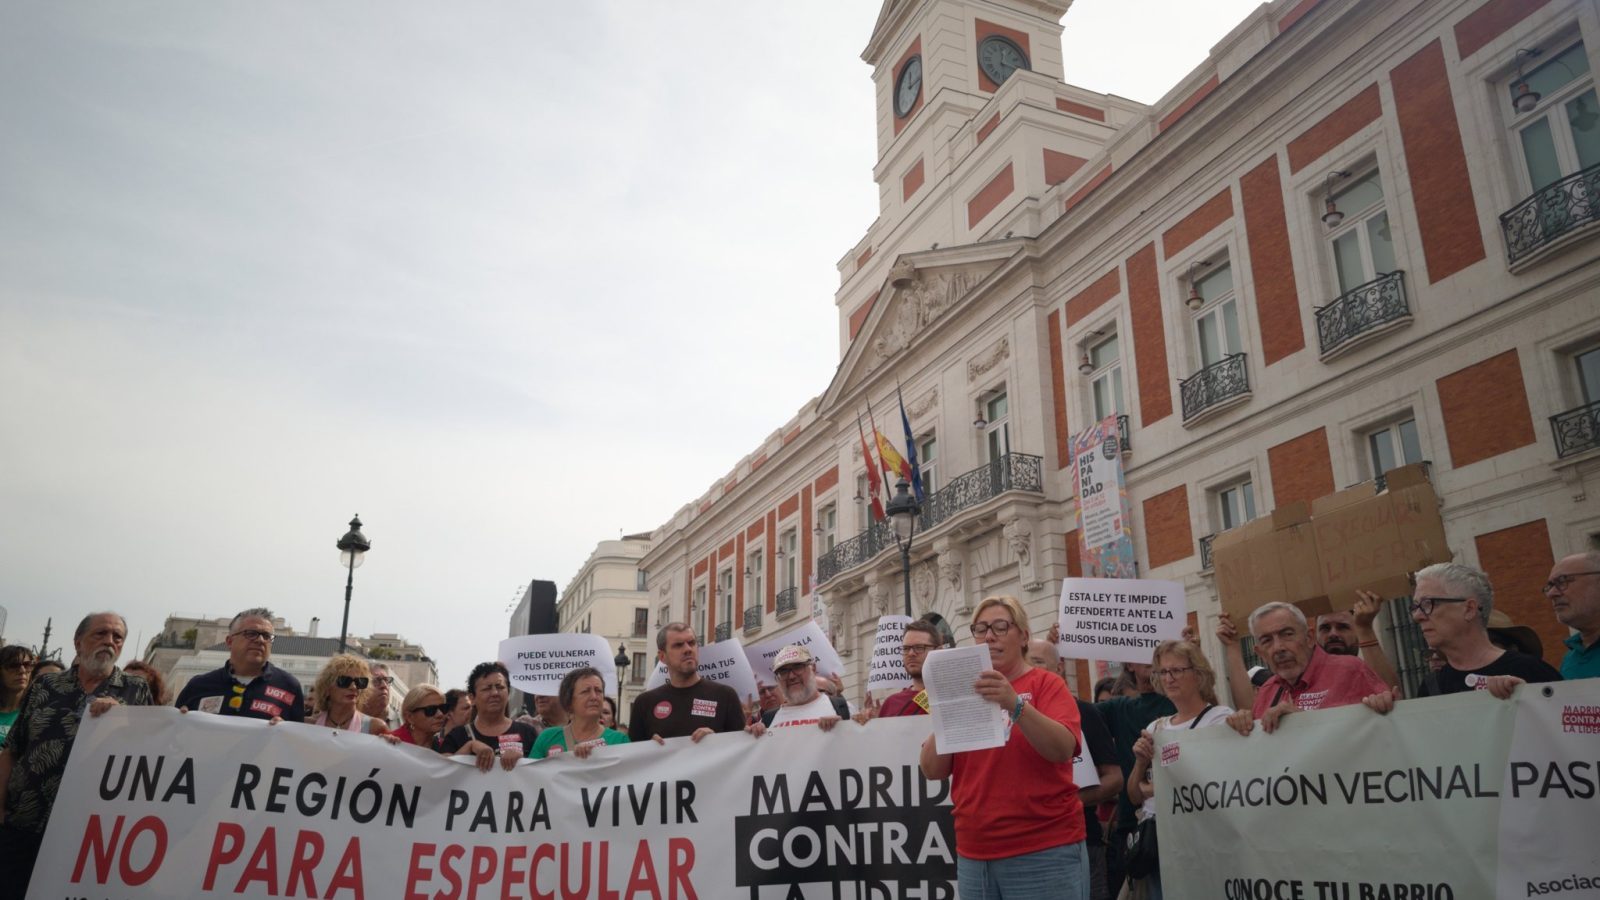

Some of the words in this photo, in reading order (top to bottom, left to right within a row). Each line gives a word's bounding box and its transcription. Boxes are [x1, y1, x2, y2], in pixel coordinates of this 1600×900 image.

[1080, 452, 1095, 467] HIS
[1080, 465, 1093, 478] PA
[1081, 476, 1091, 489] NI
[1082, 482, 1104, 498] DAD
[1069, 592, 1091, 601] ESTA
[1093, 593, 1111, 602] LEY
[1114, 594, 1126, 603] TE
[1128, 594, 1168, 605] IMPIDE
[1064, 606, 1126, 617] DEFENDERTE
[1127, 609, 1156, 619] ANTE
[1158, 610, 1173, 620] LA
[1076, 621, 1118, 631] JUSTICIA
[1120, 623, 1135, 633] DE
[1137, 624, 1157, 634] LOS
[1061, 633, 1096, 644] ABUSOS
[517, 651, 547, 660] PUEDE
[548, 649, 596, 658] VULNERAR
[524, 662, 541, 671] TUS
[542, 661, 590, 670] DERECHOS
[718, 658, 736, 668] TUS
[718, 671, 730, 680] DE
[265, 685, 285, 699] UGT
[252, 700, 273, 713] UGT
[1563, 724, 1576, 733] LA
[99, 754, 196, 805] UNA
[230, 763, 421, 828] REGIÓN
[445, 788, 551, 833] PARA
[581, 780, 698, 828] VIVIR
[750, 765, 950, 816] MADRID
[1172, 767, 1327, 814] ASOCIACIÓN
[1334, 763, 1499, 804] VECINAL
[749, 821, 955, 870] CONTRA
[70, 814, 168, 887] NO
[202, 822, 364, 900] PARA
[404, 837, 699, 900] ESPECULAR
[1224, 878, 1304, 900] CONOCE
[1314, 880, 1350, 900] TU
[1359, 882, 1454, 900] BARRIO
